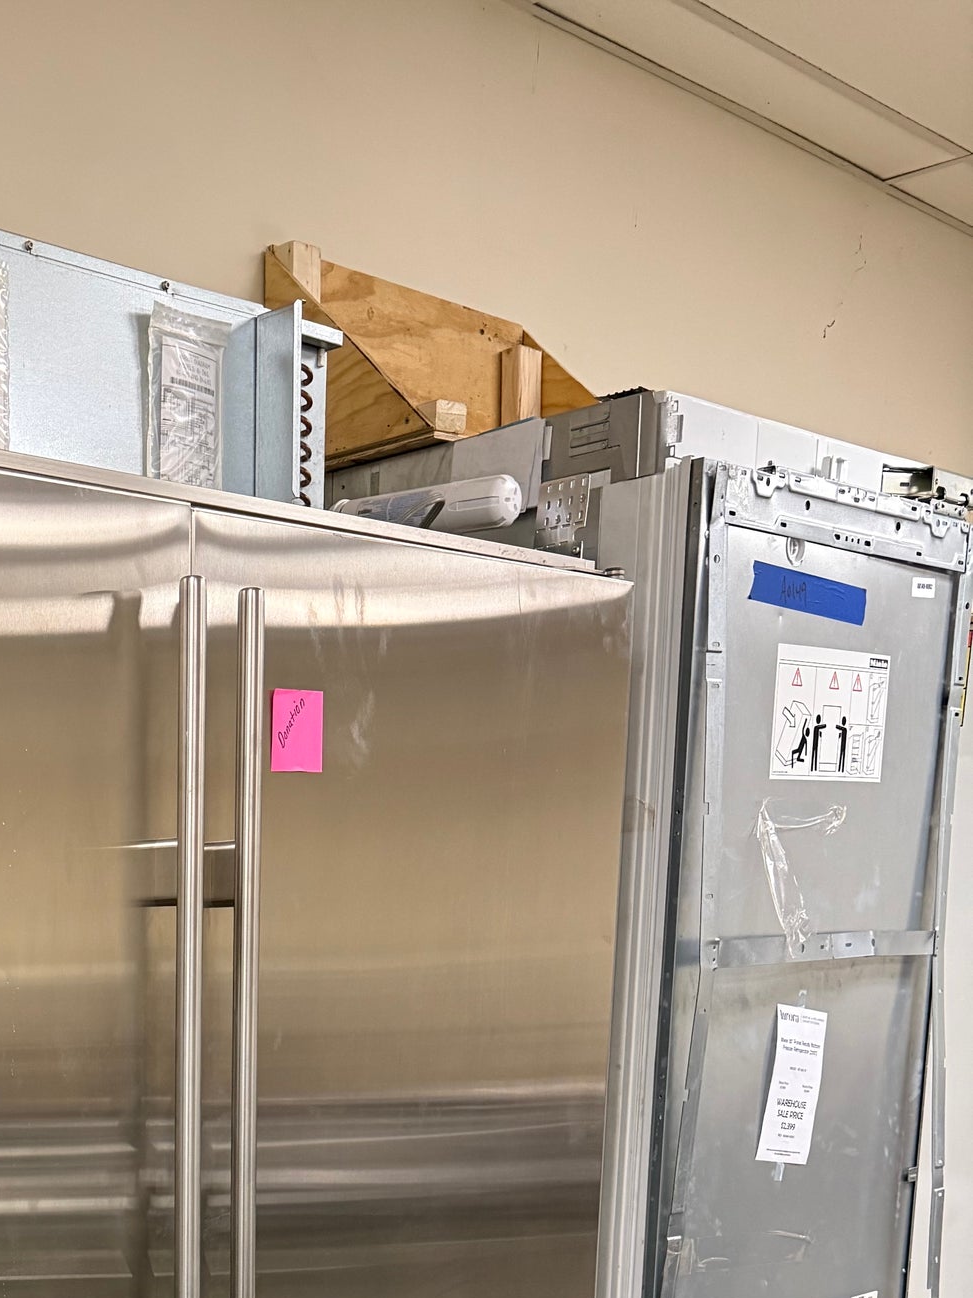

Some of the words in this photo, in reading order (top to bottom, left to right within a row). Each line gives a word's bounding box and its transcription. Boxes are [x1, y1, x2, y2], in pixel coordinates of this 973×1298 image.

[277, 698, 306, 749] Donation
[777, 1098, 807, 1109] WAREHOUSE
[777, 1109, 789, 1118] SALE
[790, 1111, 804, 1120] PRICE
